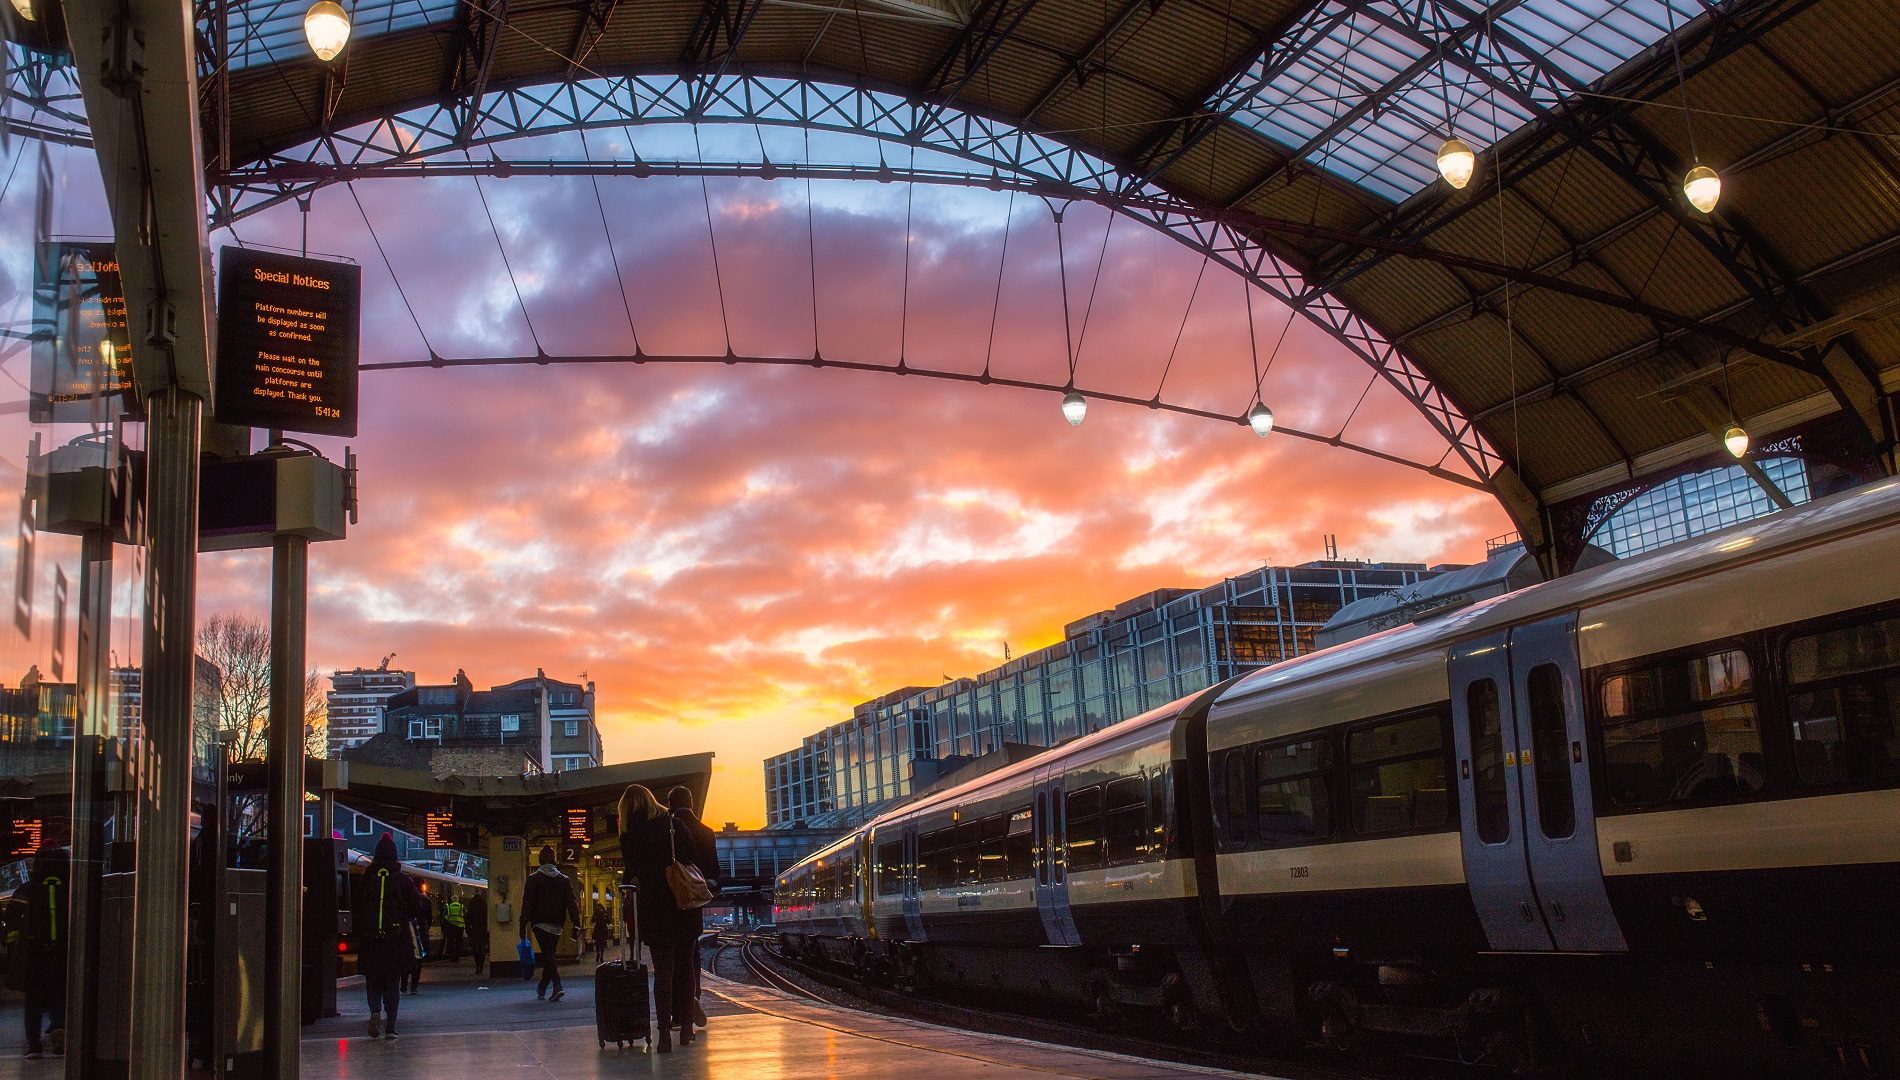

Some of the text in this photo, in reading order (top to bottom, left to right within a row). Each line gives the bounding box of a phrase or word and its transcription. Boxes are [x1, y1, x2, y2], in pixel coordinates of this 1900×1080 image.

[254, 268, 330, 290] Special Notices
[255, 302, 327, 320] Platform numbers will
[257, 314, 266, 323] be
[267, 316, 298, 328] displayed
[309, 323, 325, 332] soon
[278, 331, 313, 342] confirmed.
[258, 351, 320, 367] Please wait on the
[255, 363, 323, 379] main concourse until
[264, 376, 313, 389] platforms are
[253, 387, 286, 399] displayed.
[287, 390, 308, 401] Thank
[227, 772, 244, 785] nly
[566, 848, 575, 861] 2
[1289, 866, 1310, 879] 72803
